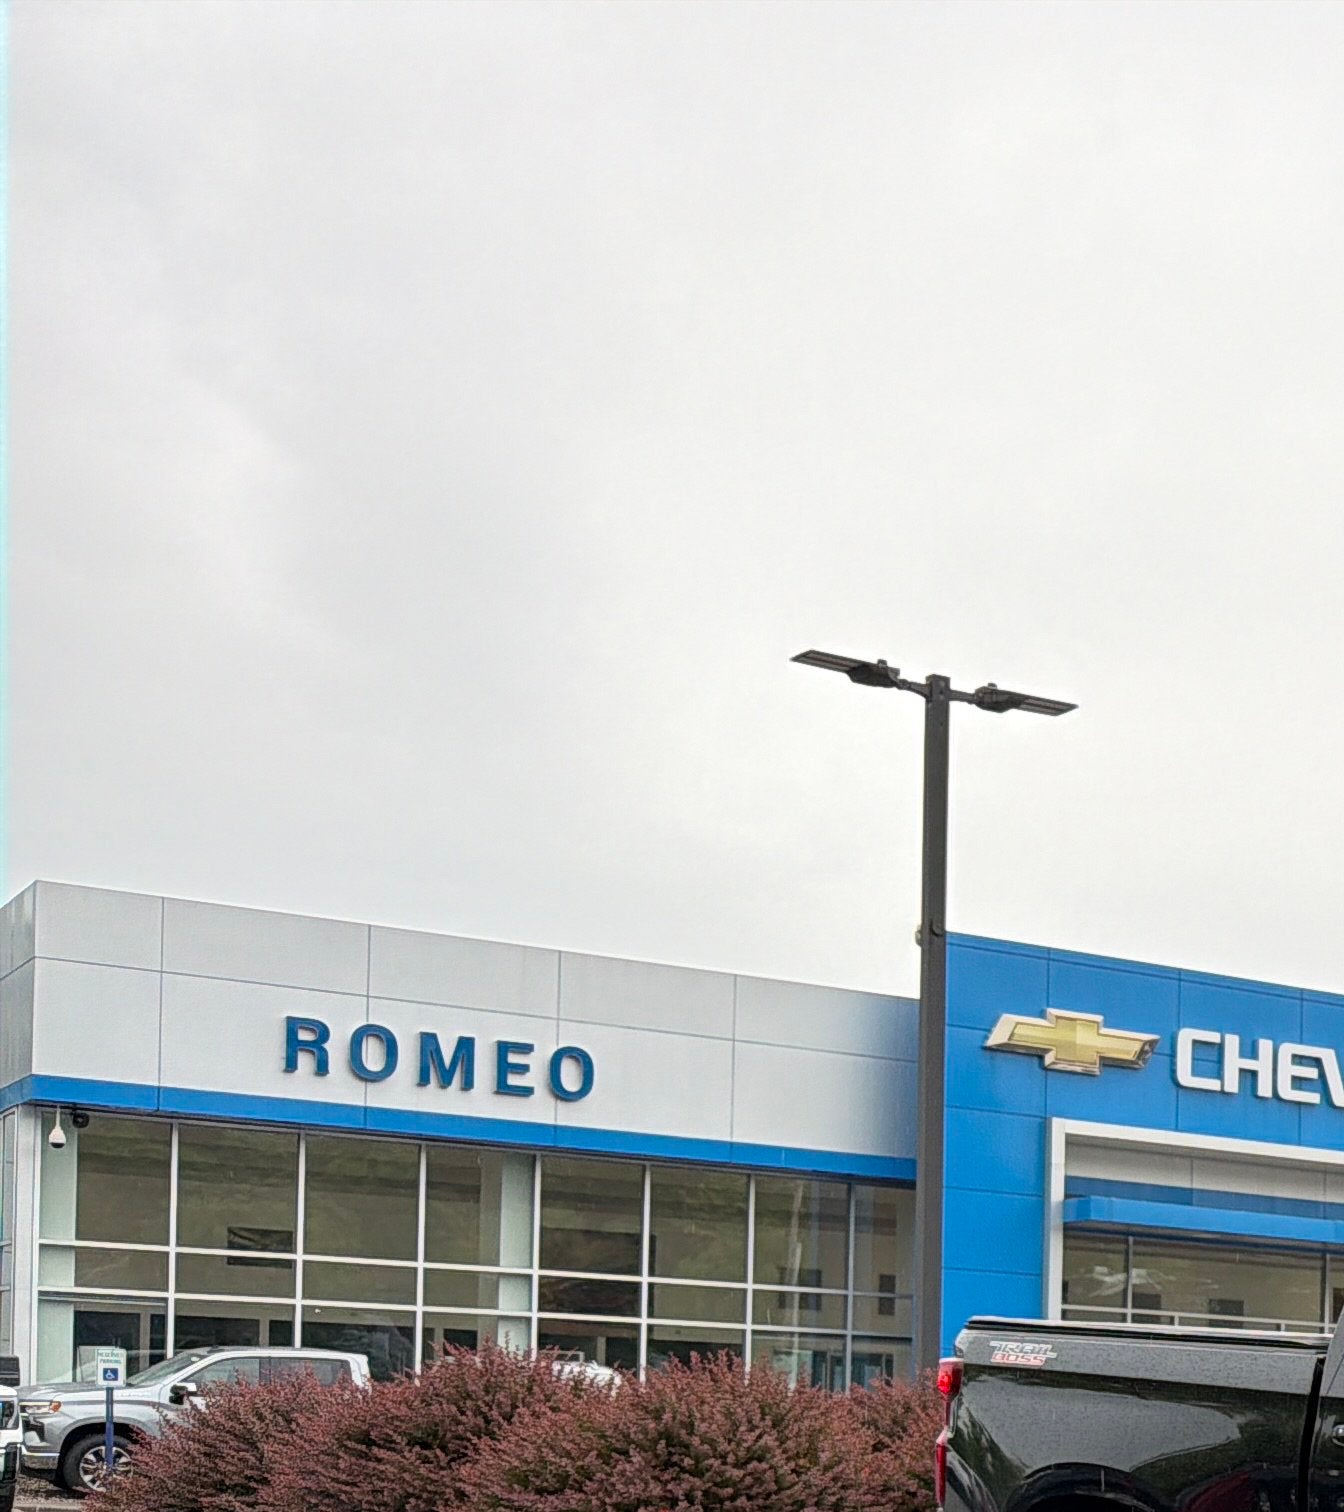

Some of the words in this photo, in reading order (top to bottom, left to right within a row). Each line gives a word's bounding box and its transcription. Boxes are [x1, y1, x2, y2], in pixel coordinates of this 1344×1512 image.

[283, 1015, 595, 1102] ROMEO
[990, 1341, 1057, 1358] TRAIL
[991, 1352, 1047, 1366] BOSS
